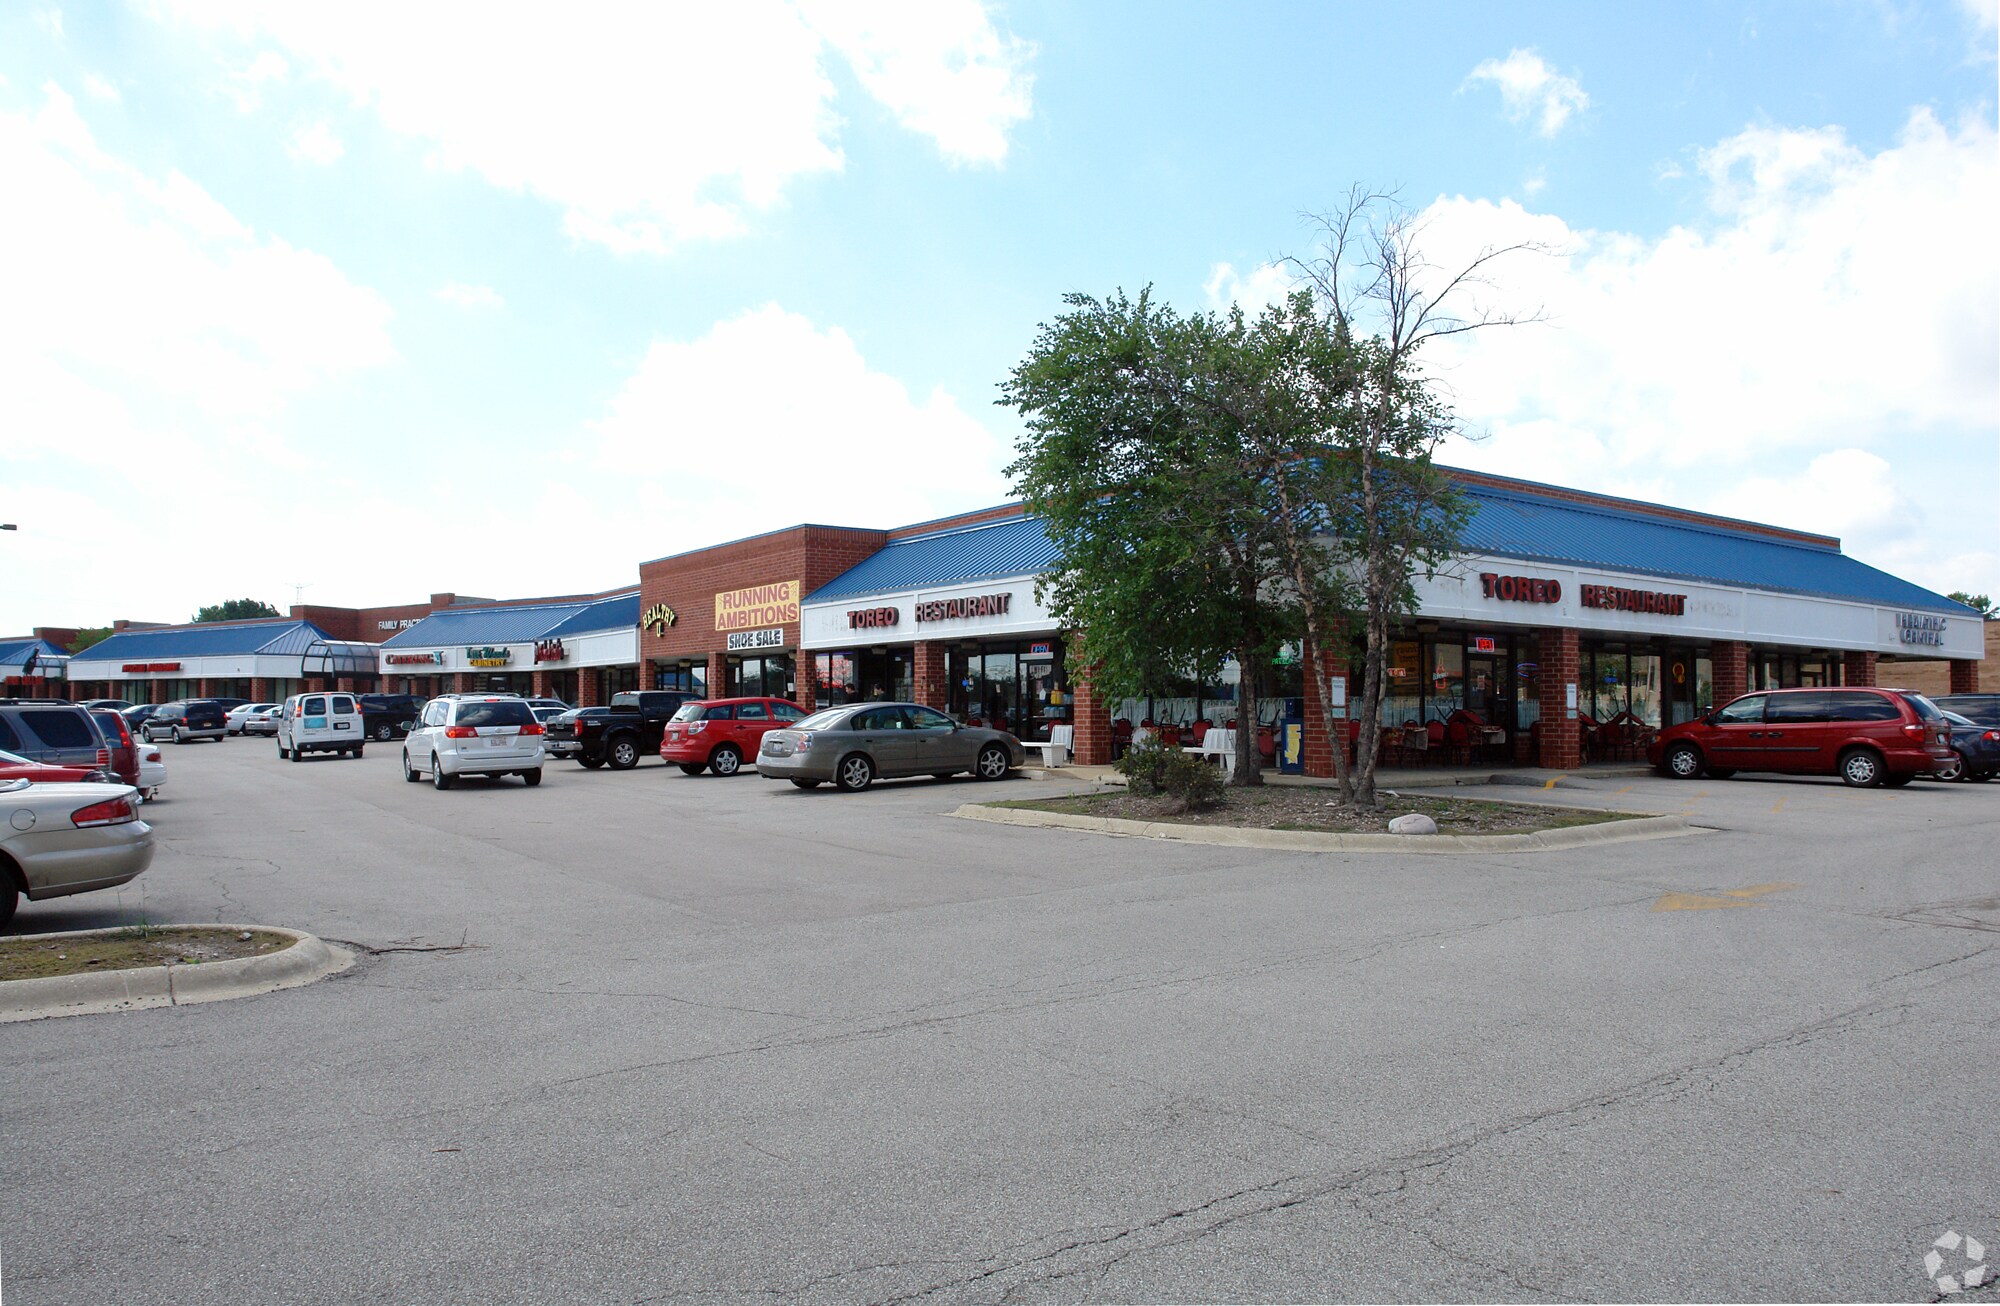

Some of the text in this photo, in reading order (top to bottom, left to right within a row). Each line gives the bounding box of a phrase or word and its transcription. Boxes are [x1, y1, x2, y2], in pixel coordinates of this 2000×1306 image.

[723, 583, 789, 609] RUNNING
[1480, 573, 1687, 615] TOREO RESTAURANT
[643, 604, 676, 630] HEALTHY
[717, 603, 797, 629] AMBITIONS
[847, 593, 1012, 629] TOREO RESTAURANT
[379, 620, 398, 630] FAMILY
[729, 630, 780, 649] SHOE SALE
[470, 659, 506, 667] CABINETRY
